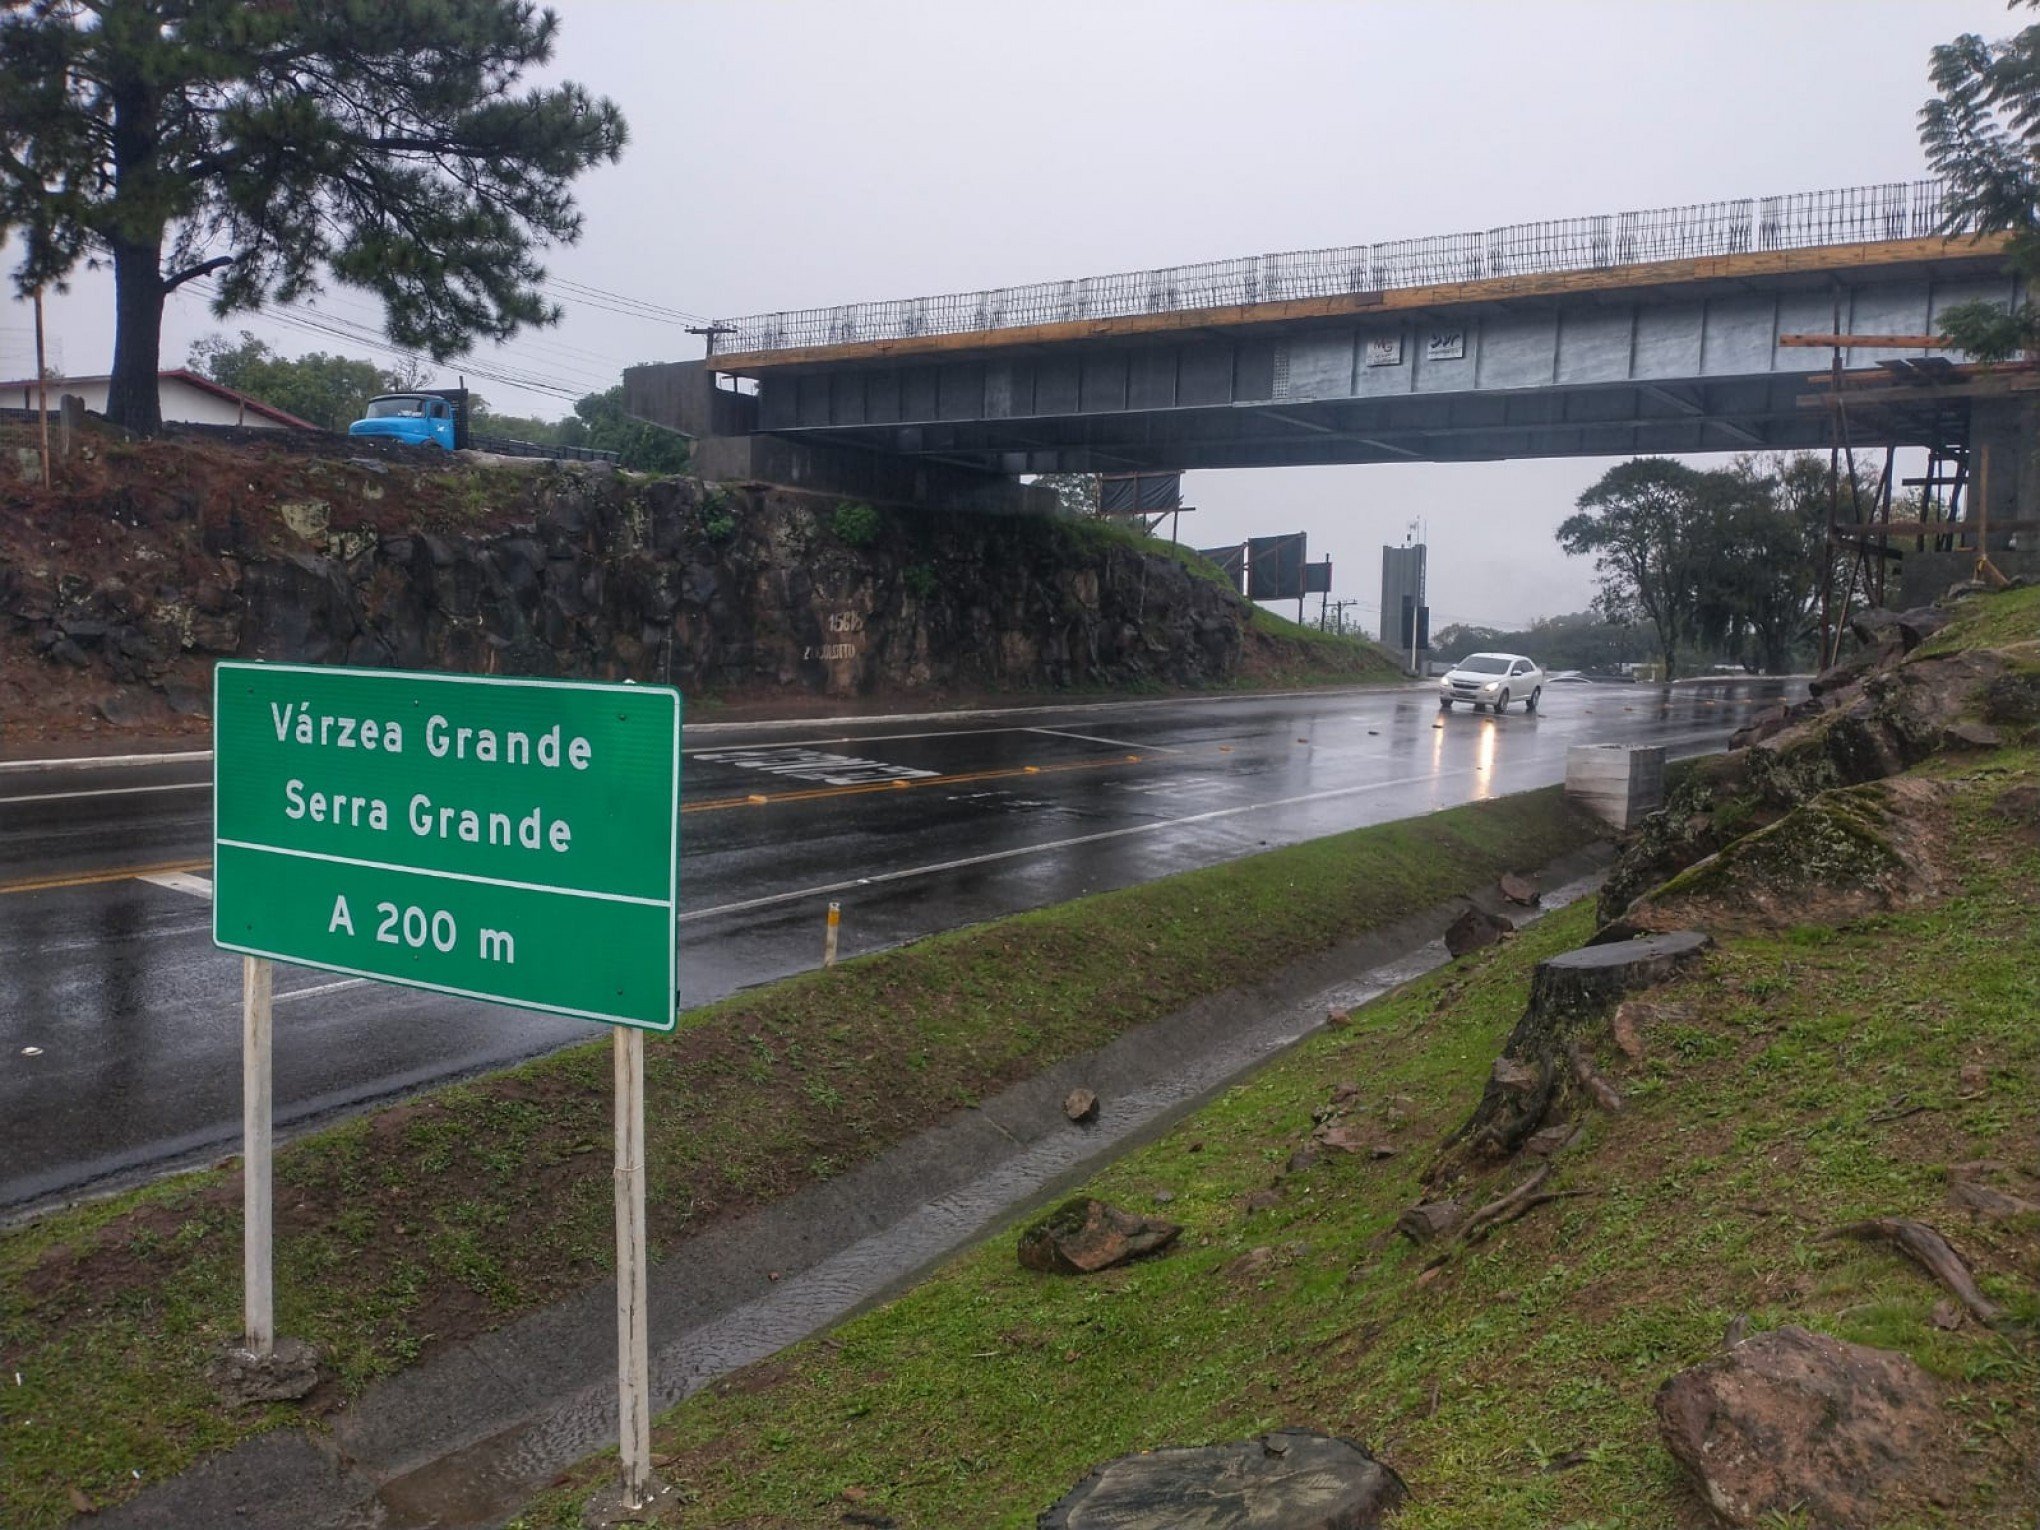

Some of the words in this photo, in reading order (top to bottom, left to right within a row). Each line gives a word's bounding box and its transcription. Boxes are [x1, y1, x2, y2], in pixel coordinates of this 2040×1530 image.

[271, 702, 403, 753] Várzea
[426, 714, 592, 770] Grande
[285, 779, 388, 831] Serra
[409, 794, 571, 853] Grande
[329, 895, 355, 936] A
[377, 902, 456, 952] 200
[480, 928, 514, 964] m
